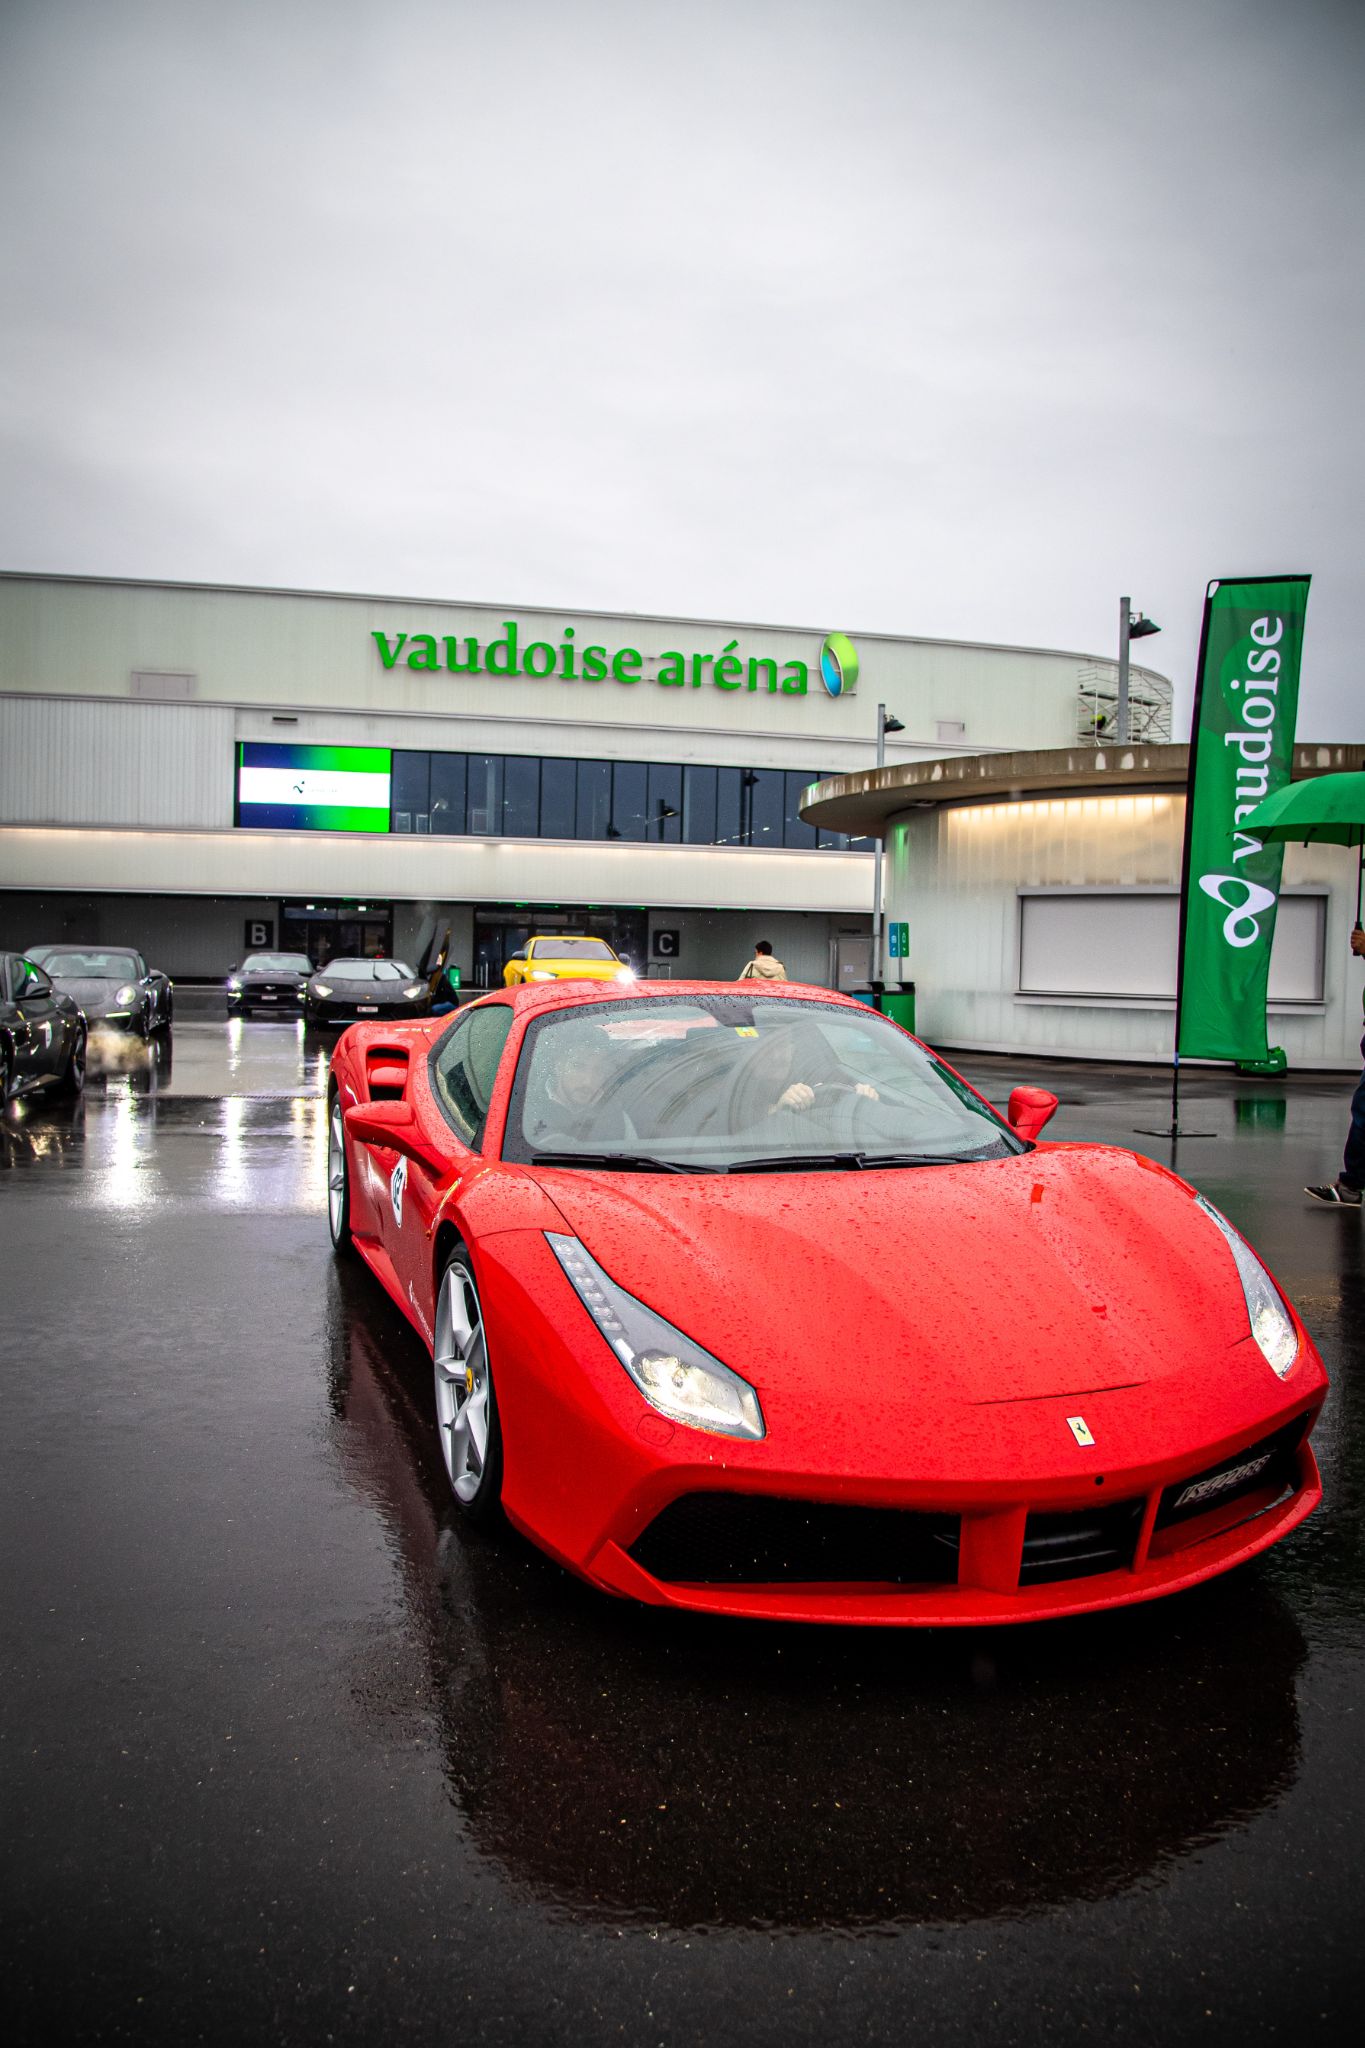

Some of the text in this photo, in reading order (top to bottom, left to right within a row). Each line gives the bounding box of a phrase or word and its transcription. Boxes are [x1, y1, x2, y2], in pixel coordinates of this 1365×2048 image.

[371, 621, 809, 695] vaudoise aréna
[251, 924, 267, 945] B
[659, 933, 673, 954] C
